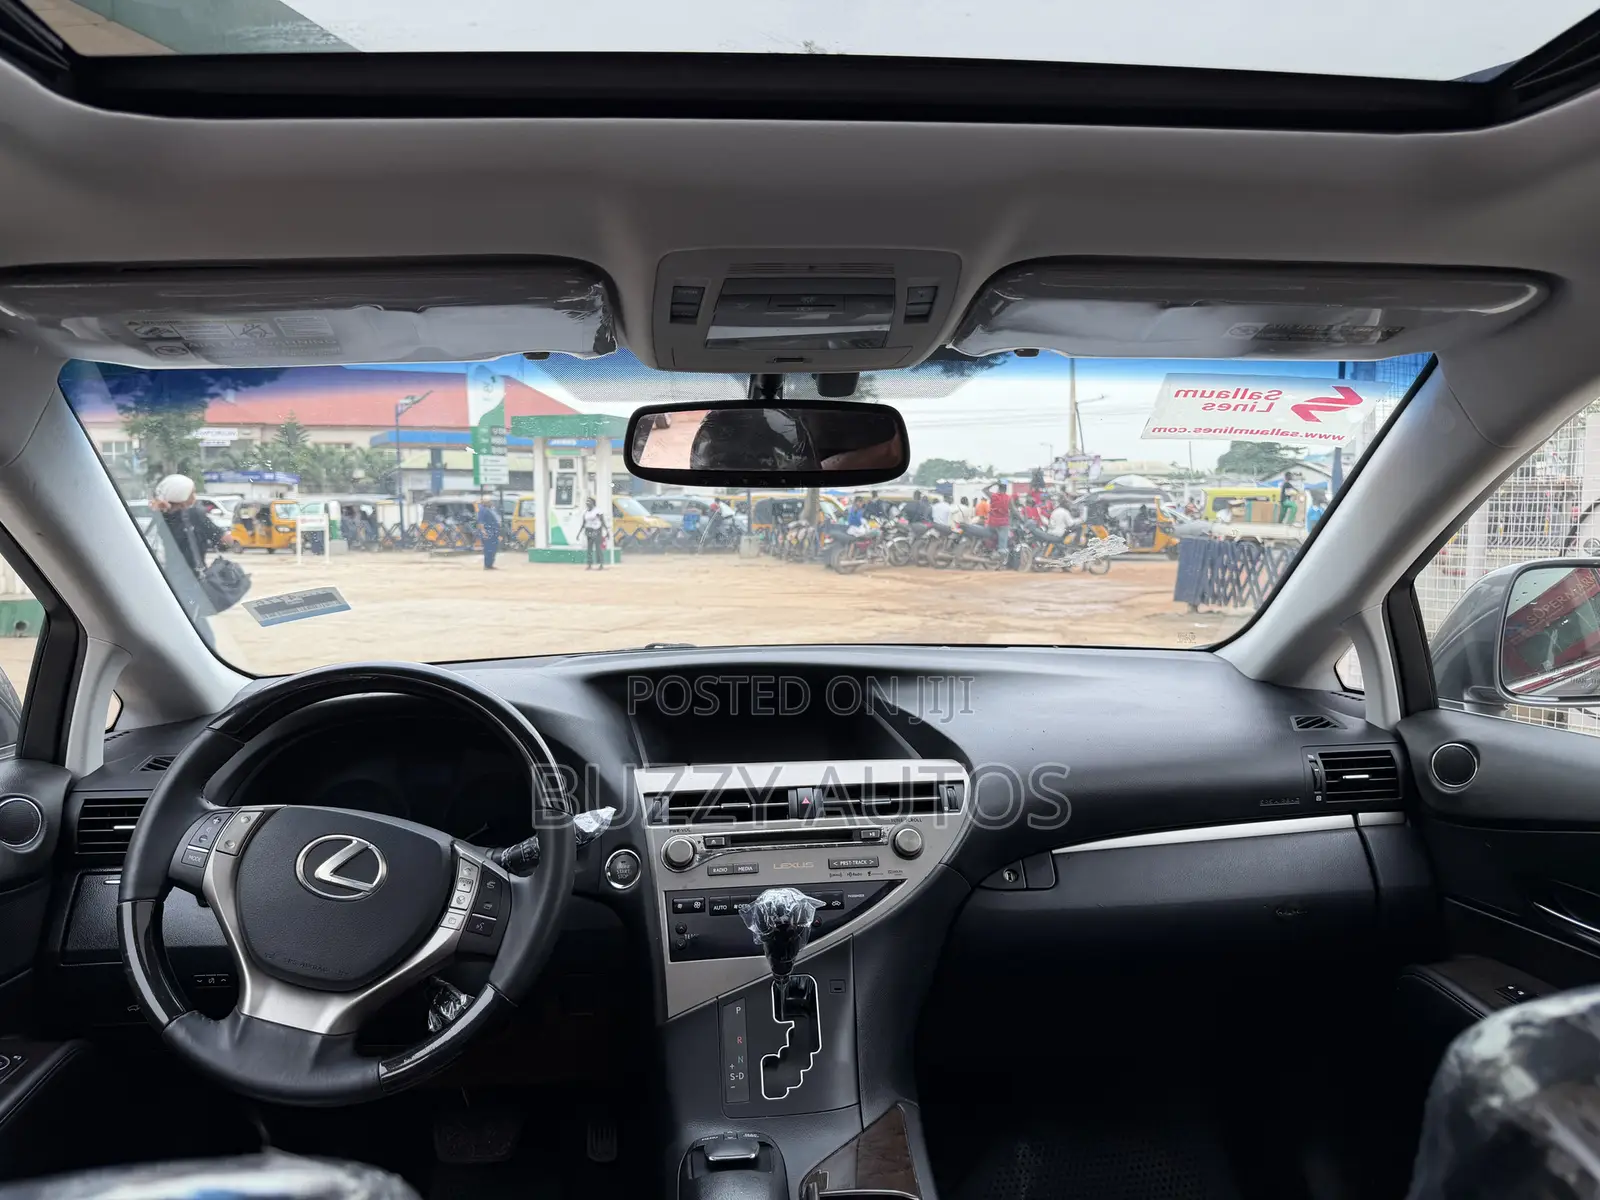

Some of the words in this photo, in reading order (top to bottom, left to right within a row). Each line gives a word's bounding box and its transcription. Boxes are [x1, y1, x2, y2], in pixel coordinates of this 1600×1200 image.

[772, 861, 815, 870] LEXUS
[735, 1006, 742, 1014] P
[736, 1036, 743, 1044] R
[737, 1055, 744, 1064] N
